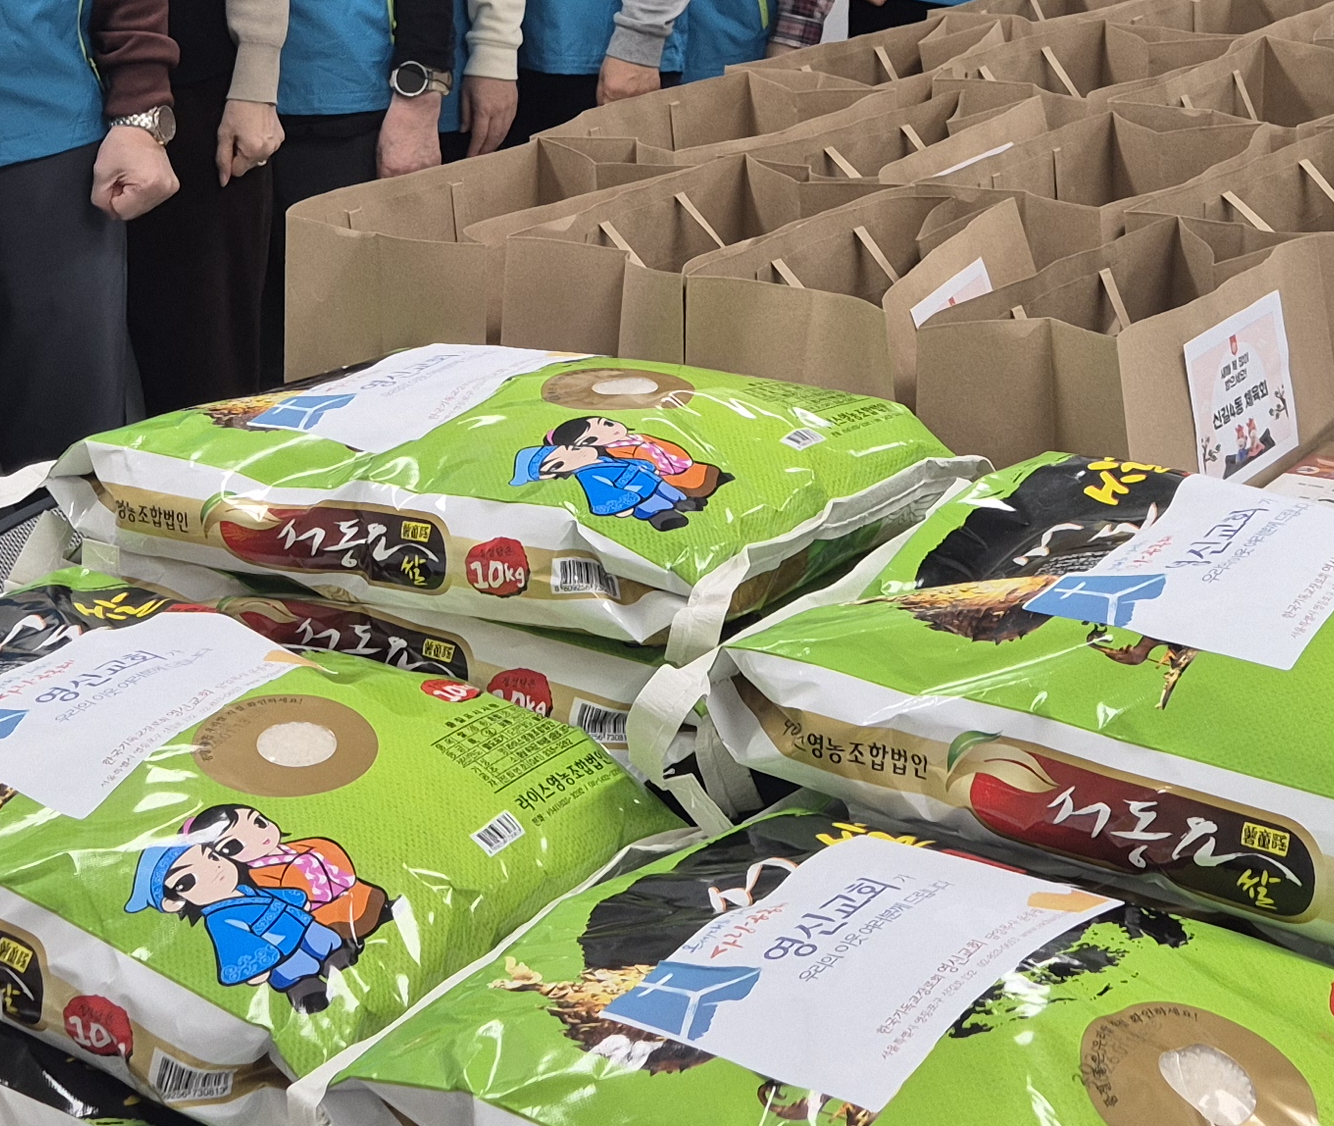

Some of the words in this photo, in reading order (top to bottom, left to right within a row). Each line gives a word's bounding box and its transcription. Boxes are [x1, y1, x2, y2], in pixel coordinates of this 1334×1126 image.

[1212, 394, 1244, 431] 신길4동
[1244, 378, 1270, 410] 체육회
[400, 554, 429, 587] 쌀
[472, 560, 528, 590] 10kg
[35, 649, 167, 704] 영신교회
[55, 697, 95, 722] 우리의
[91, 686, 120, 708] 이웃
[167, 688, 214, 717] 영신교회
[513, 748, 616, 813] 라이스영농조합법인
[1047, 786, 1303, 889] 서동요
[1235, 867, 1283, 910] 쌀
[763, 876, 905, 962] 영신교회
[798, 954, 840, 984] 우리의
[835, 932, 866, 960] 이웃
[859, 903, 916, 938] 여러분께
[908, 880, 957, 909] 드립니다
[876, 974, 946, 1036] 한국기독교장로회
[936, 937, 990, 977] 영신교회
[880, 1024, 917, 1061] 서울특별시
[913, 995, 947, 1028] 영등포구
